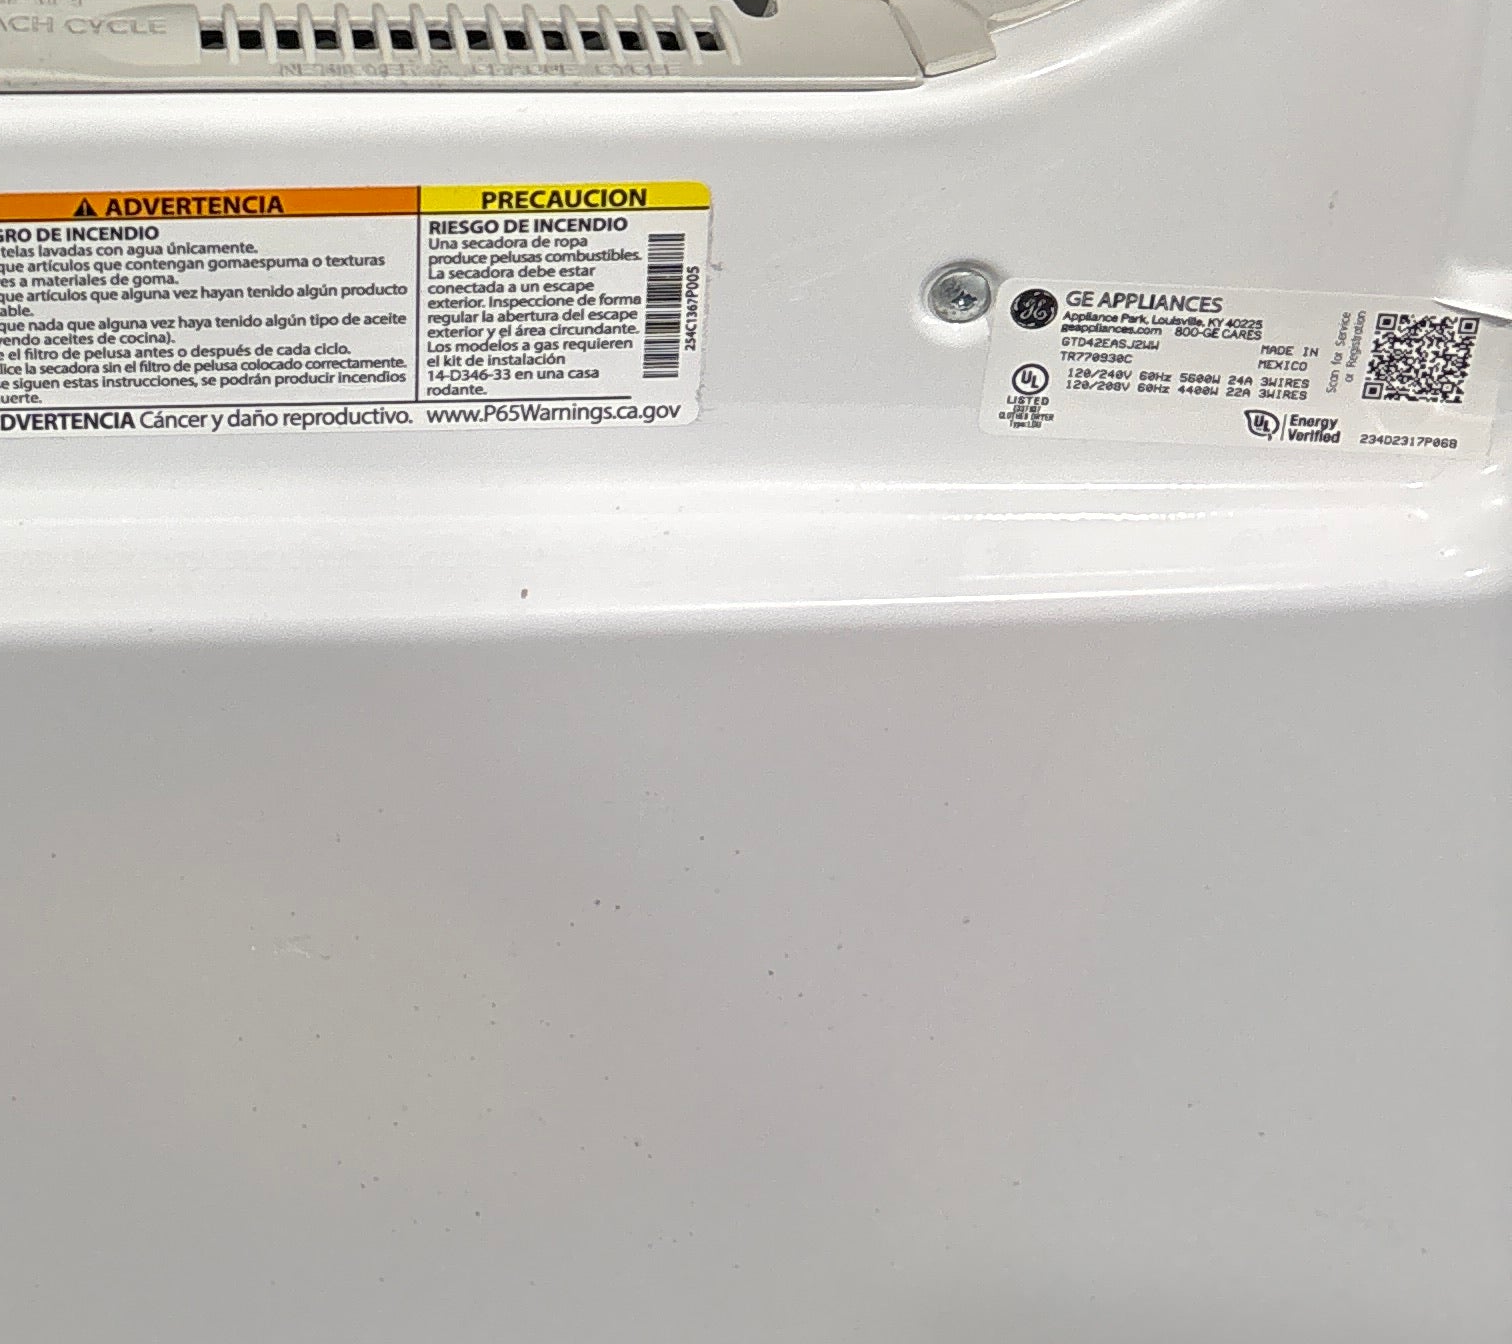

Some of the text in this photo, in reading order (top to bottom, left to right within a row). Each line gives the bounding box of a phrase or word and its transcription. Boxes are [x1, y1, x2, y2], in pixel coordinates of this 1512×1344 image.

[63, 16, 168, 37] CYCLE
[105, 195, 285, 216] ADVERTENCIA
[482, 188, 647, 209] PRECAUCION
[36, 229, 61, 242] DE
[65, 227, 159, 242] INCENDIO
[428, 218, 627, 235] RIESGO DE INCENDIO
[0, 245, 34, 258] telas
[37, 244, 92, 257] lavadas
[95, 246, 123, 256] con
[126, 245, 163, 259] agua
[166, 241, 258, 255] únicamente.
[428, 235, 588, 251] Una secadora de ropa
[27, 259, 90, 272] artículos
[92, 261, 122, 275] que
[124, 257, 204, 274] contengan
[207, 257, 309, 273] gomaespuma
[311, 257, 322, 267] o
[325, 254, 385, 267] texturas
[428, 248, 640, 268] produce pelusas combustibles.
[427, 264, 595, 280] La secadora debe estar
[684, 265, 700, 351] 254C1367P005
[1065, 290, 1224, 313] GE APPLIANCES
[1062, 311, 1118, 324] Appliance
[1121, 313, 1149, 325] Park,
[1207, 317, 1225, 328] KY
[1225, 318, 1263, 330] 40225
[1174, 326, 1263, 341] 800-GE CARES
[426, 352, 565, 367] el kit de instalación
[1260, 344, 1320, 358] MADE IN
[1257, 359, 1308, 372] MEXICO
[427, 368, 599, 382] 14-D346-33 en una casa
[1021, 369, 1039, 388] UL
[1068, 367, 1310, 389] 120/240V 60Hz 5600W 24A 3WIRES
[426, 382, 486, 396] rodante.
[1066, 379, 1308, 401] 120/208V 60Hz 4400W 22A 3WIRES
[1006, 395, 1050, 406] LISTED
[140, 410, 206, 430] Cáncer
[211, 413, 224, 432] y
[227, 409, 279, 428] daño
[282, 407, 414, 431] reproductivo.
[426, 403, 681, 424] www.P65Warnings.ca.gov
[1289, 413, 1339, 431] Energy
[1253, 414, 1270, 432] UL
[1287, 427, 1341, 444] Verified
